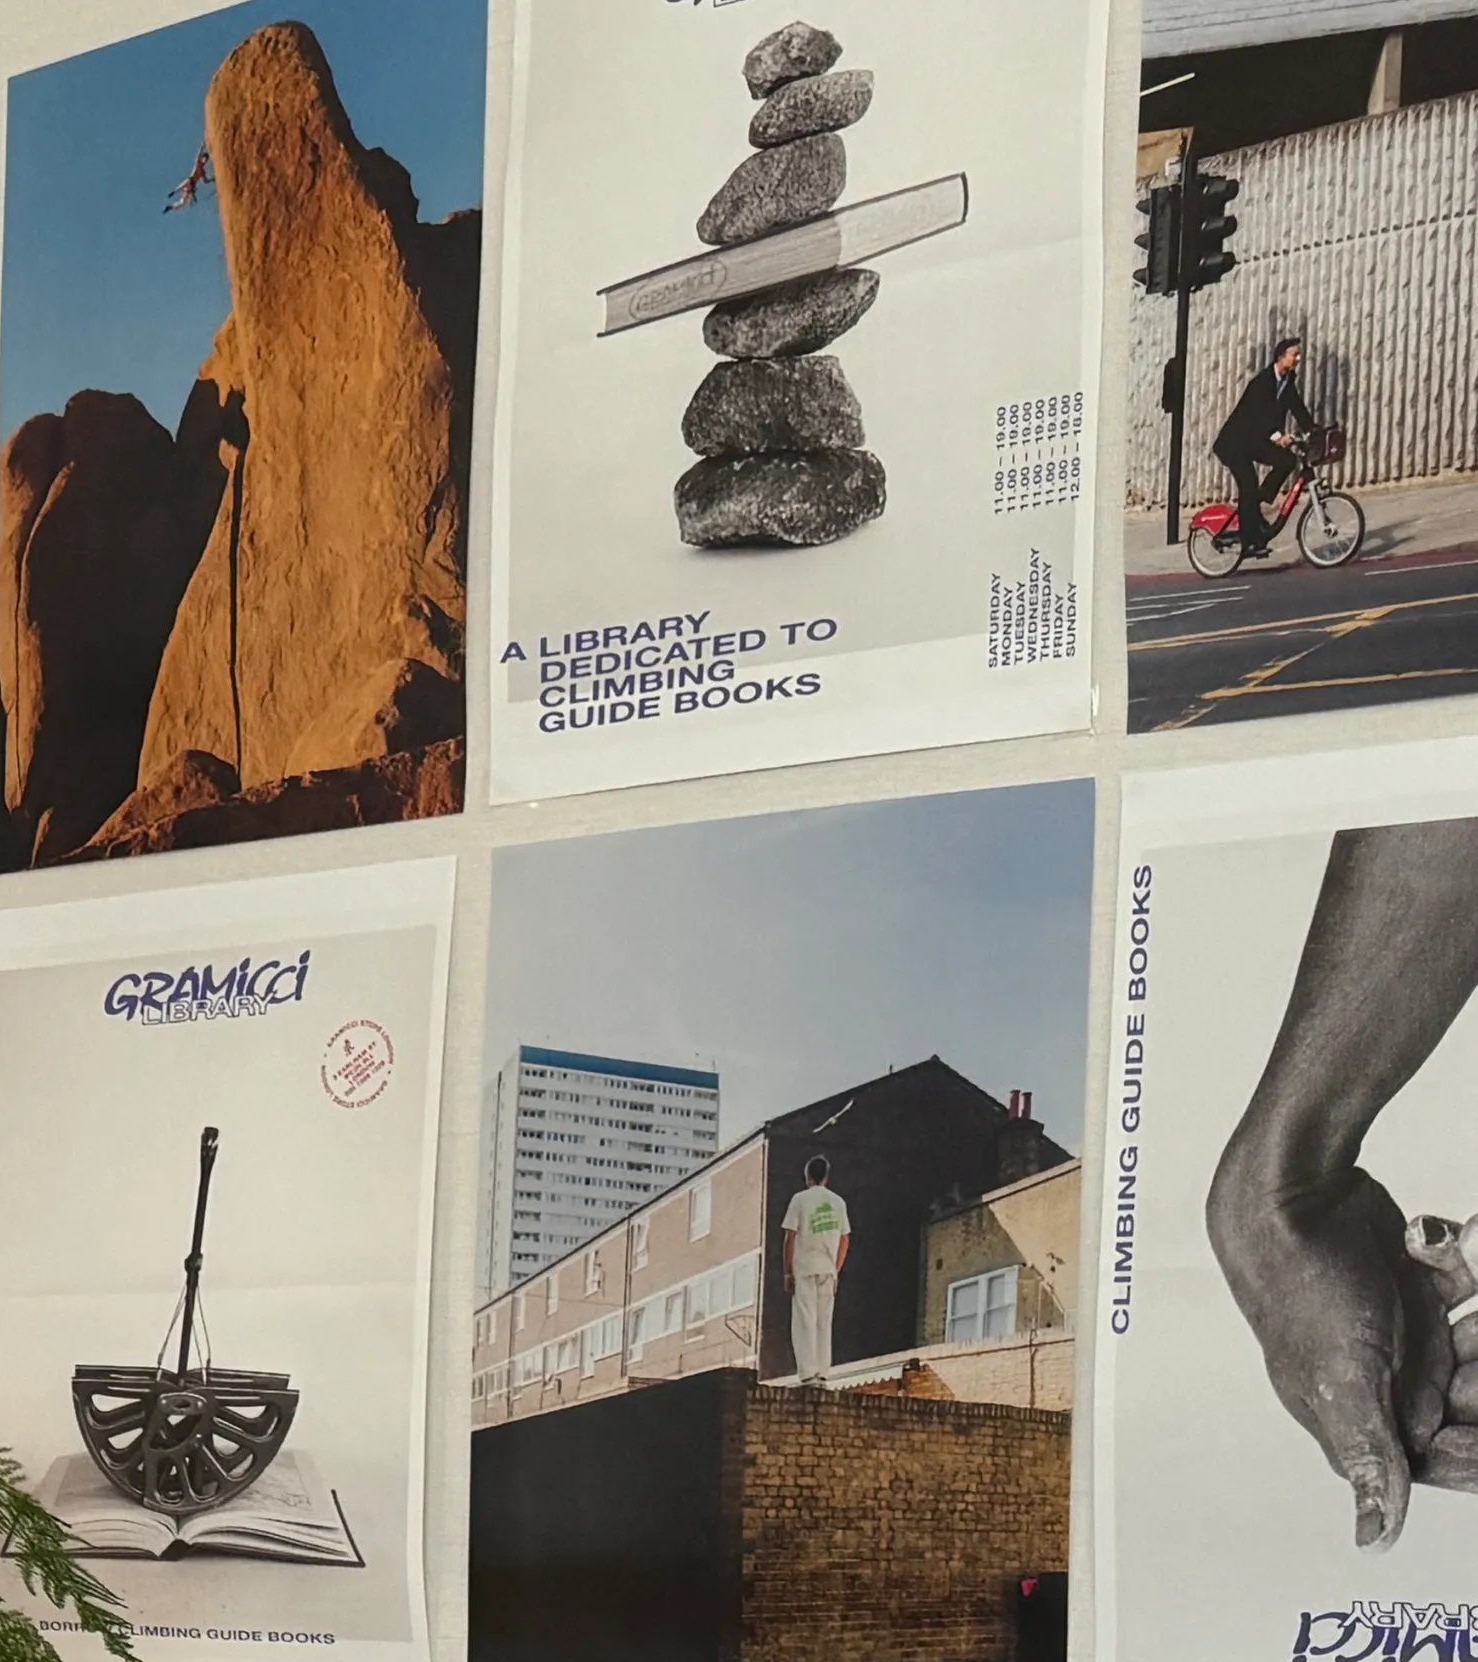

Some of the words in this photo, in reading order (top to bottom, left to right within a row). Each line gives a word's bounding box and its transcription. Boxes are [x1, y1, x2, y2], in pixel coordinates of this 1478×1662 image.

[994, 471, 1004, 515] 11.00
[1058, 460, 1068, 504] 11.00
[1071, 457, 1081, 502] 12.00
[1001, 586, 1013, 666] MONDAY
[1007, 469, 1017, 513] 11.00
[1014, 581, 1026, 665] TUESDAY
[1020, 467, 1030, 511] 11.00
[1027, 548, 1039, 663] WEDNESDAY
[1033, 464, 1043, 508] 11.00
[1040, 561, 1052, 661] THURSDAY
[1046, 462, 1056, 506] 11.00
[500, 641, 526, 663] A
[540, 610, 711, 658] LIBRARY
[540, 629, 767, 683] DEDICATED
[780, 618, 838, 645] TO
[989, 572, 1001, 668] SATURDAY
[1053, 594, 1065, 659] FRIDAY
[1066, 583, 1077, 657] SUNDAY
[538, 697, 660, 733] GUIDE
[674, 673, 822, 714] BOOKS
[539, 659, 735, 708] CLIMBING
[1128, 864, 1153, 1001] BOOKS
[141, 991, 276, 1026] LIBRARY
[1122, 1014, 1144, 1133] GUIDE
[1111, 1145, 1139, 1335] CLIMBING
[206, 1628, 262, 1642] GUIDE
[267, 1630, 336, 1645] BOOKS
